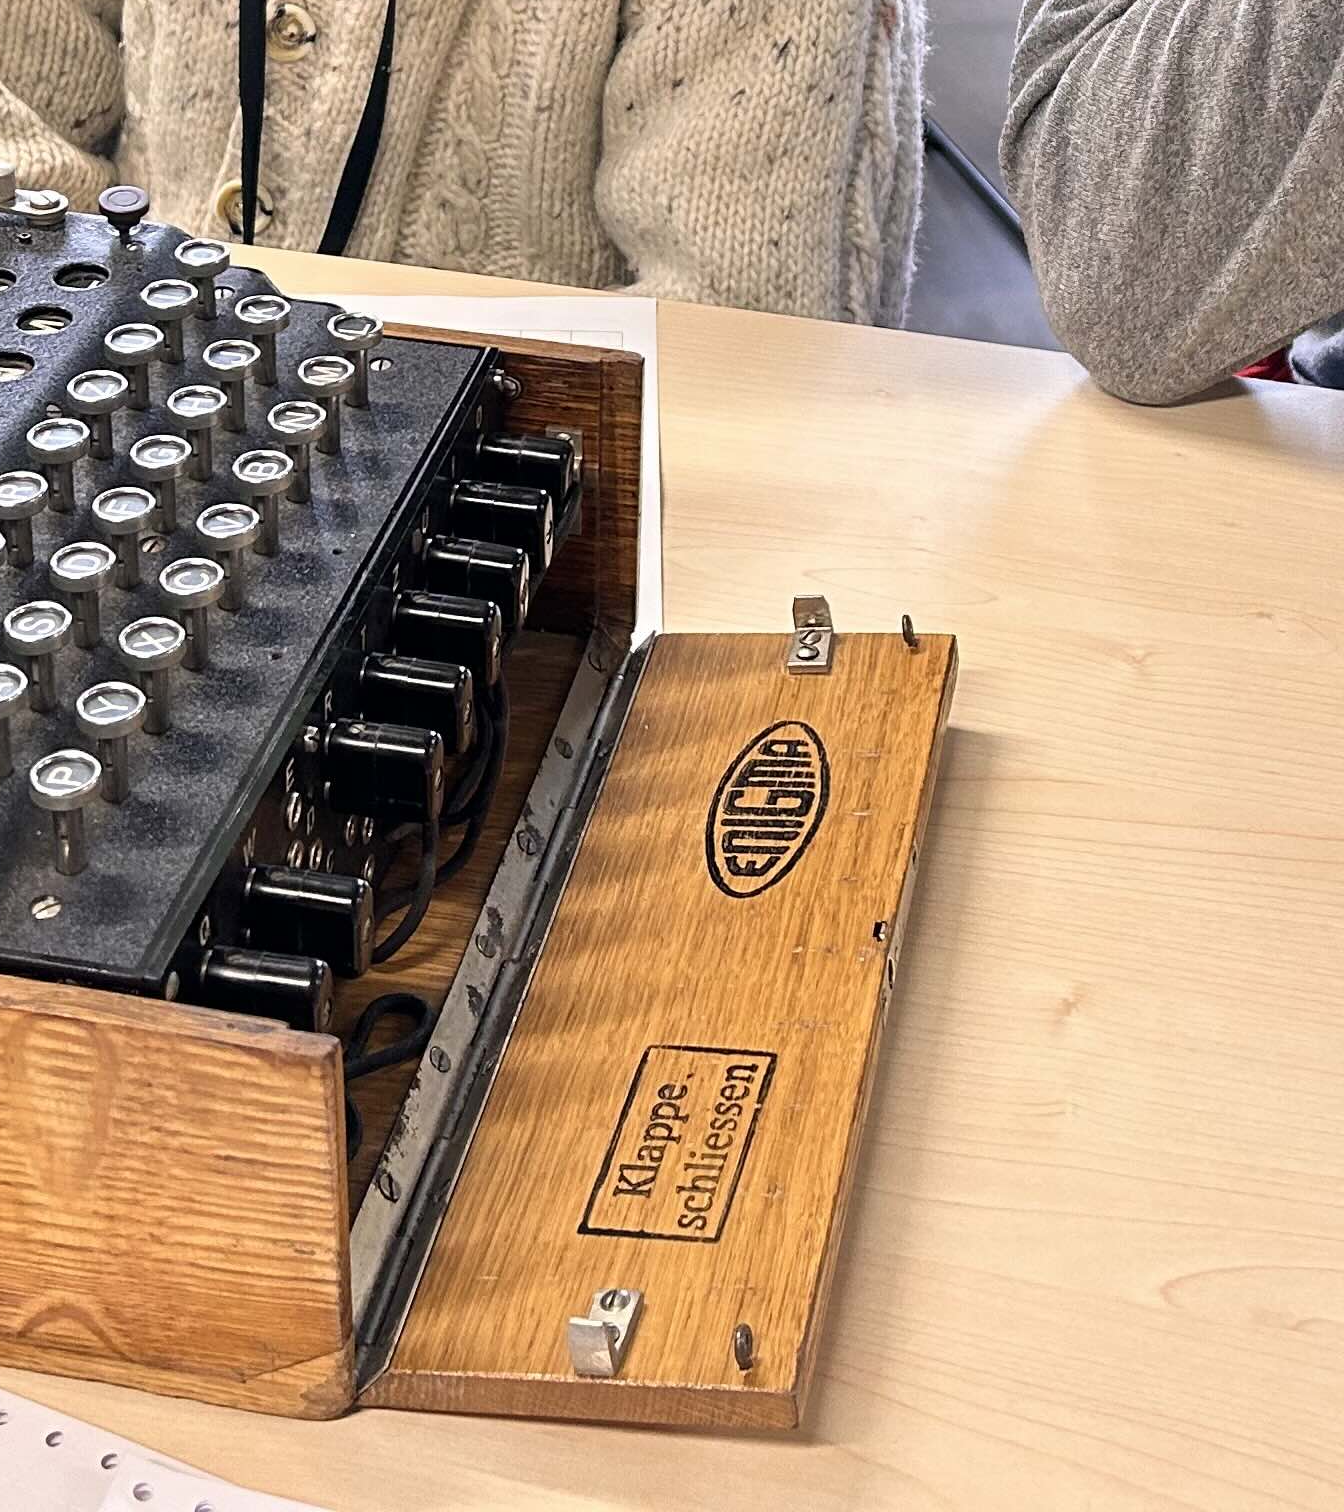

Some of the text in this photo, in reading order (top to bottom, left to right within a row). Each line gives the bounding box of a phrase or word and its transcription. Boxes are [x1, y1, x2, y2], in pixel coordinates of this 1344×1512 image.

[17, 616, 56, 635] S
[63, 554, 100, 568] D
[143, 447, 180, 462] G
[248, 305, 278, 320] K
[77, 382, 113, 398] Z
[46, 324, 372, 786] P Y X C V B N M L
[285, 757, 295, 793] E
[676, 1063, 760, 1231] schliessen
